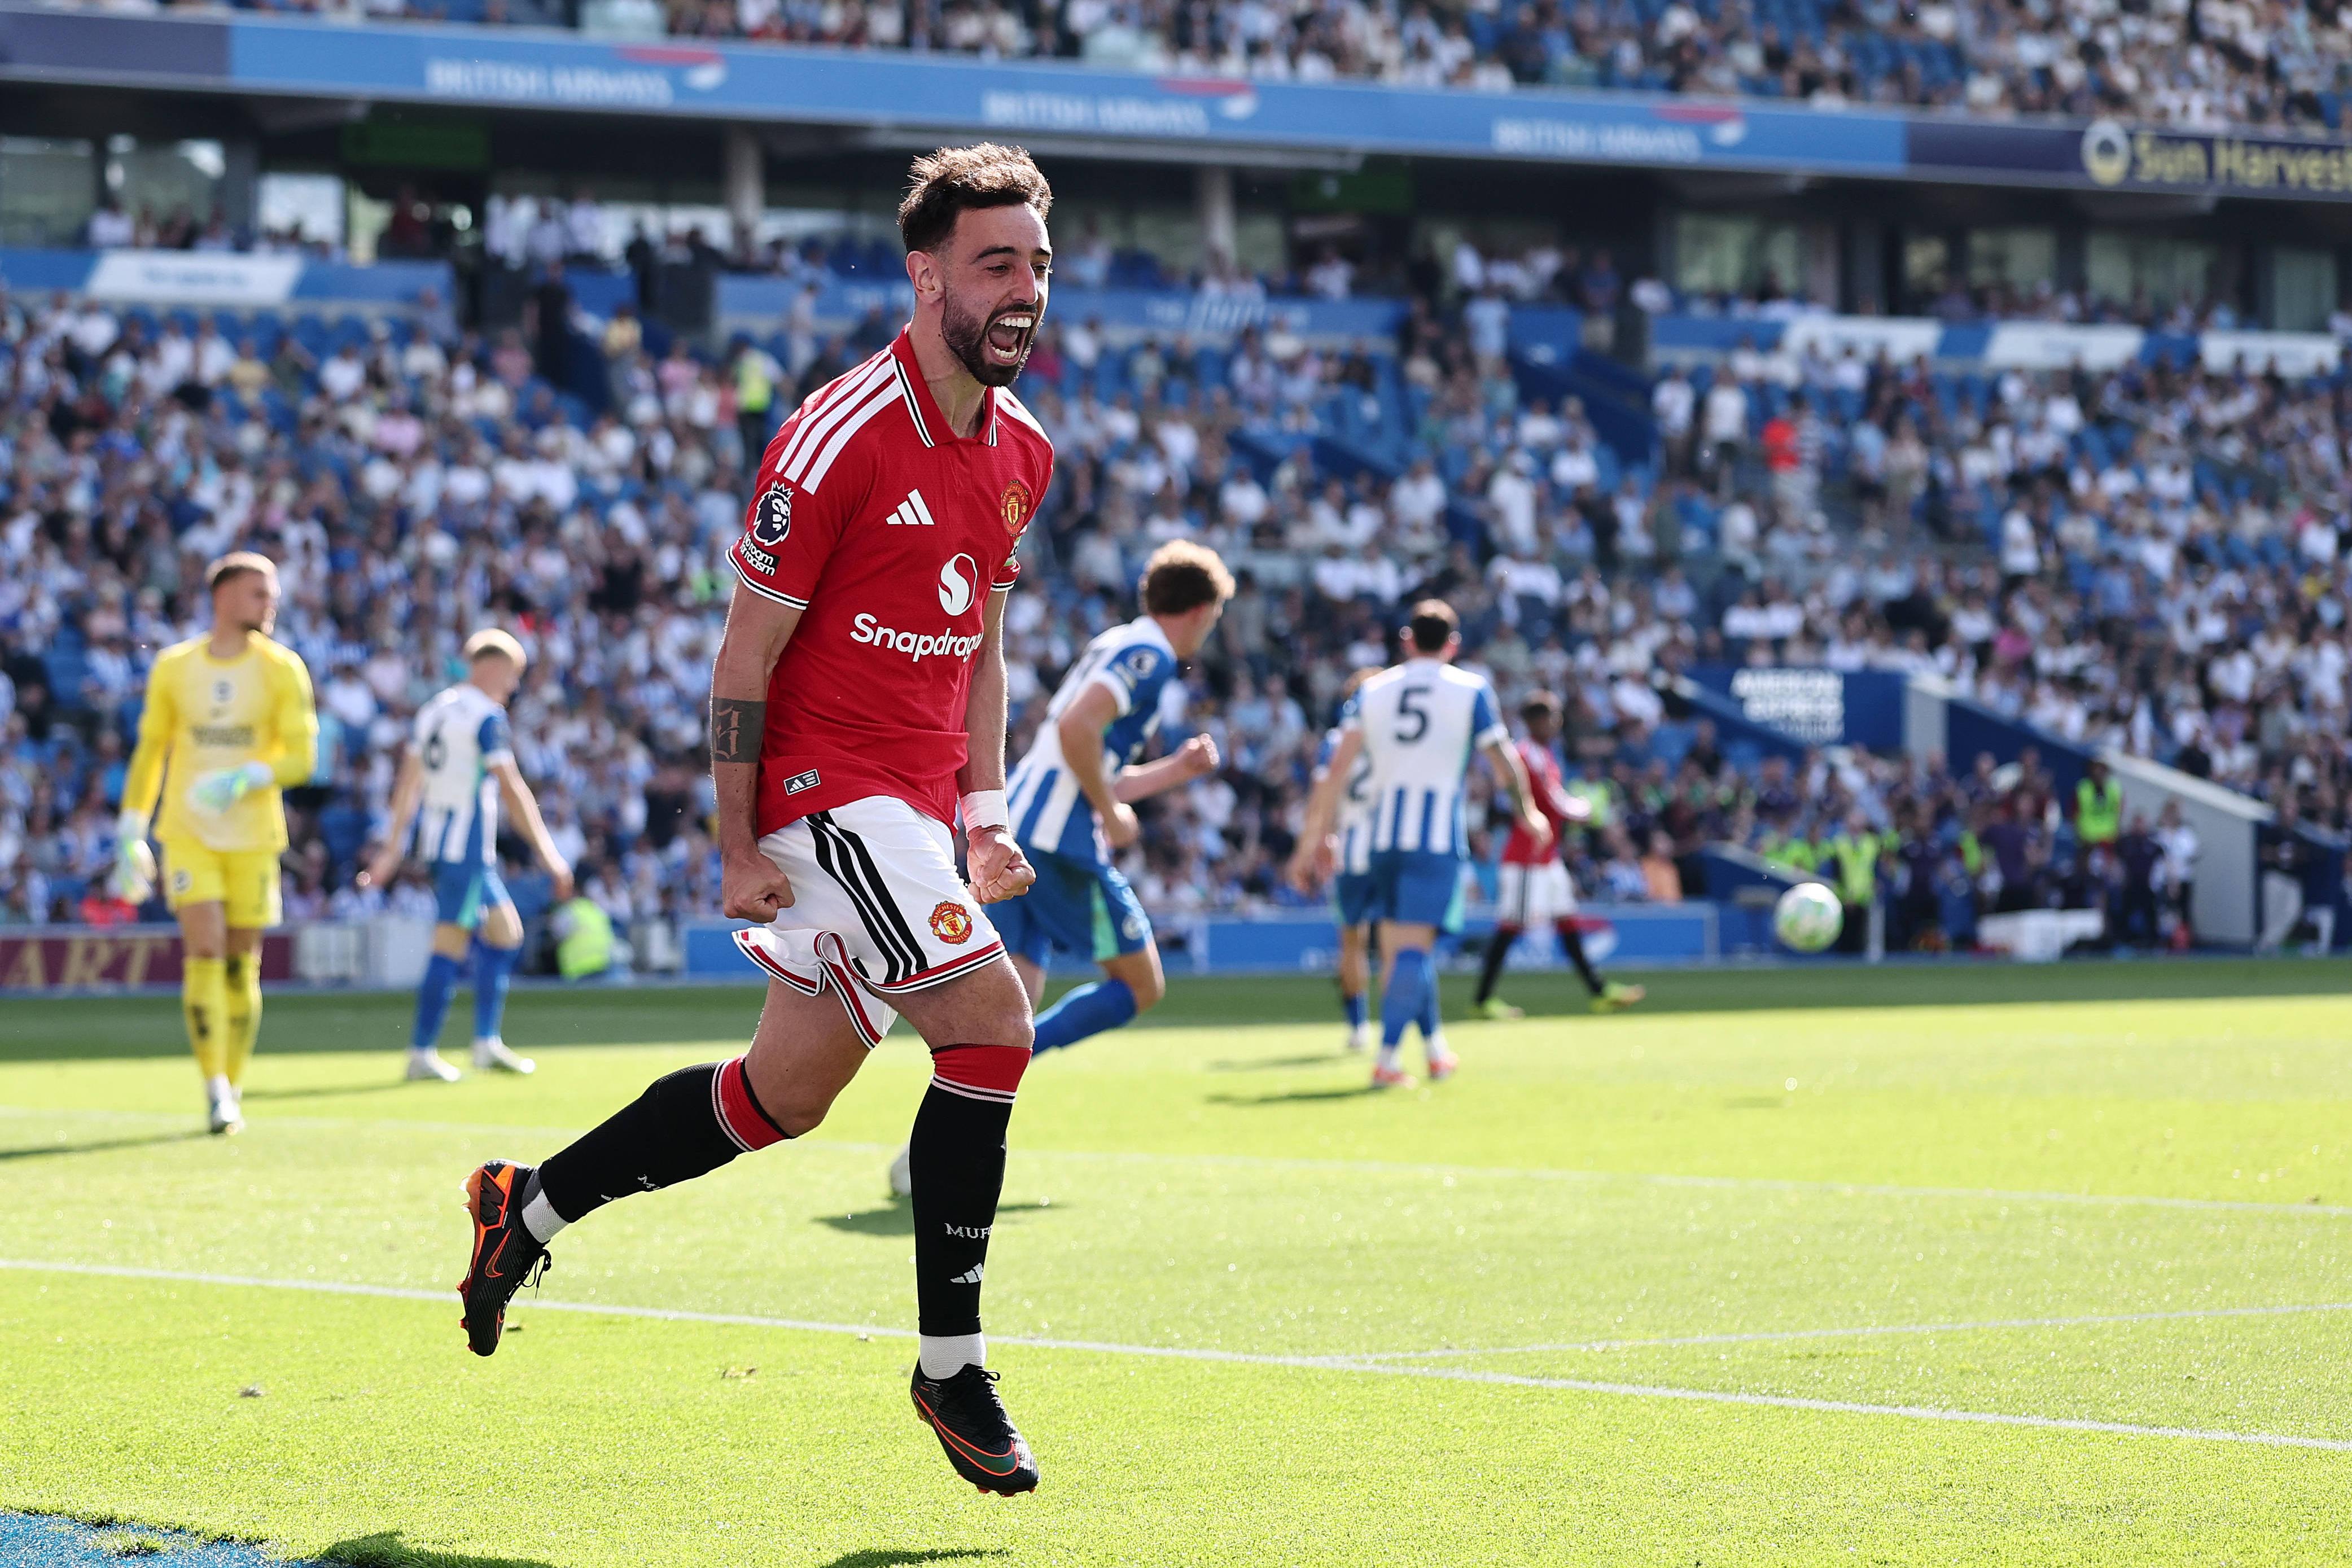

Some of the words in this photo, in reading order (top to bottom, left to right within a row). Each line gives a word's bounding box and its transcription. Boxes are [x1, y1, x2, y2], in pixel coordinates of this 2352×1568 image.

[2134, 130, 2209, 185] Sun
[744, 550, 776, 576] racism
[748, 542, 774, 566] room
[1396, 686, 1432, 745] 5
[423, 717, 449, 771] 6
[932, 904, 963, 925] MANCHESTER
[948, 930, 970, 942] UNITED
